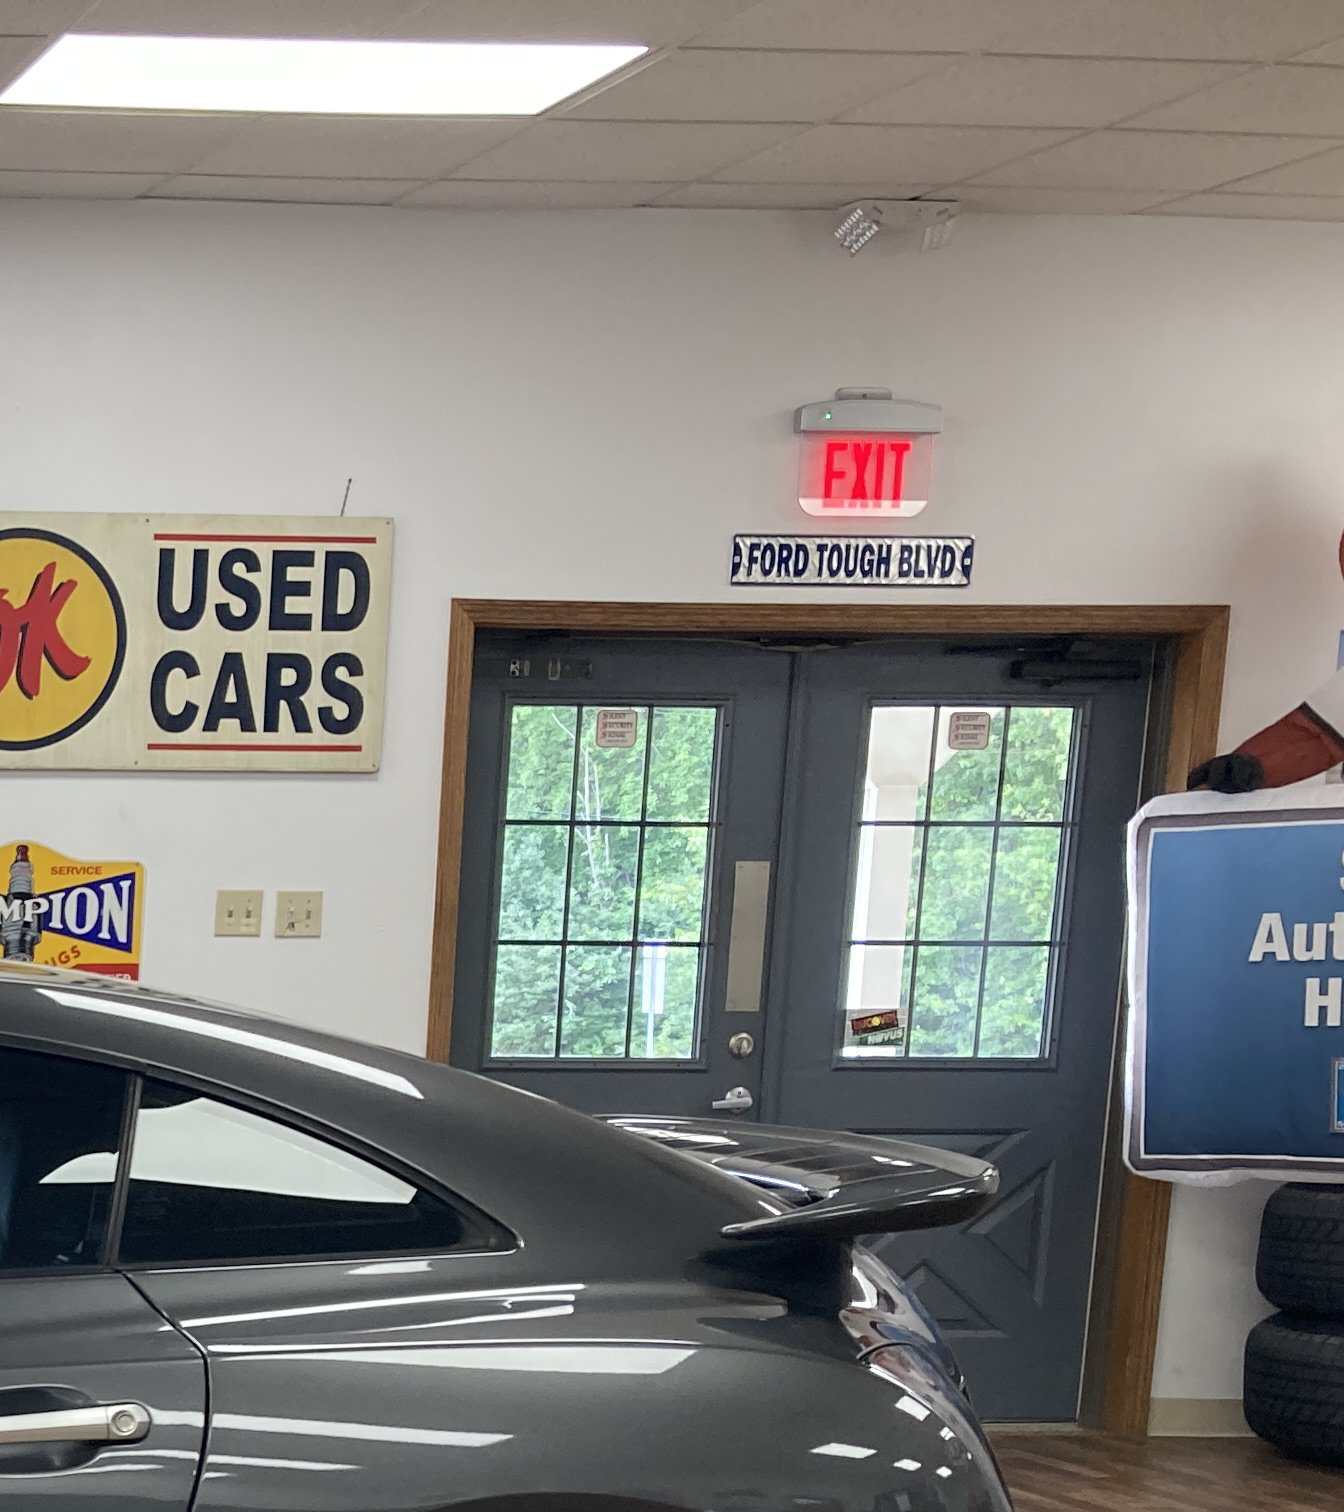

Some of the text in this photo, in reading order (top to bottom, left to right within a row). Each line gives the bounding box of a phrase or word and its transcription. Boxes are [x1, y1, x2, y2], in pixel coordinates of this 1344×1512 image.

[822, 441, 912, 508] EXIT
[156, 547, 371, 632] USED
[746, 543, 957, 578] FORD TOUGH BLVD
[150, 649, 365, 735] CARS
[50, 865, 103, 876] SERVICE
